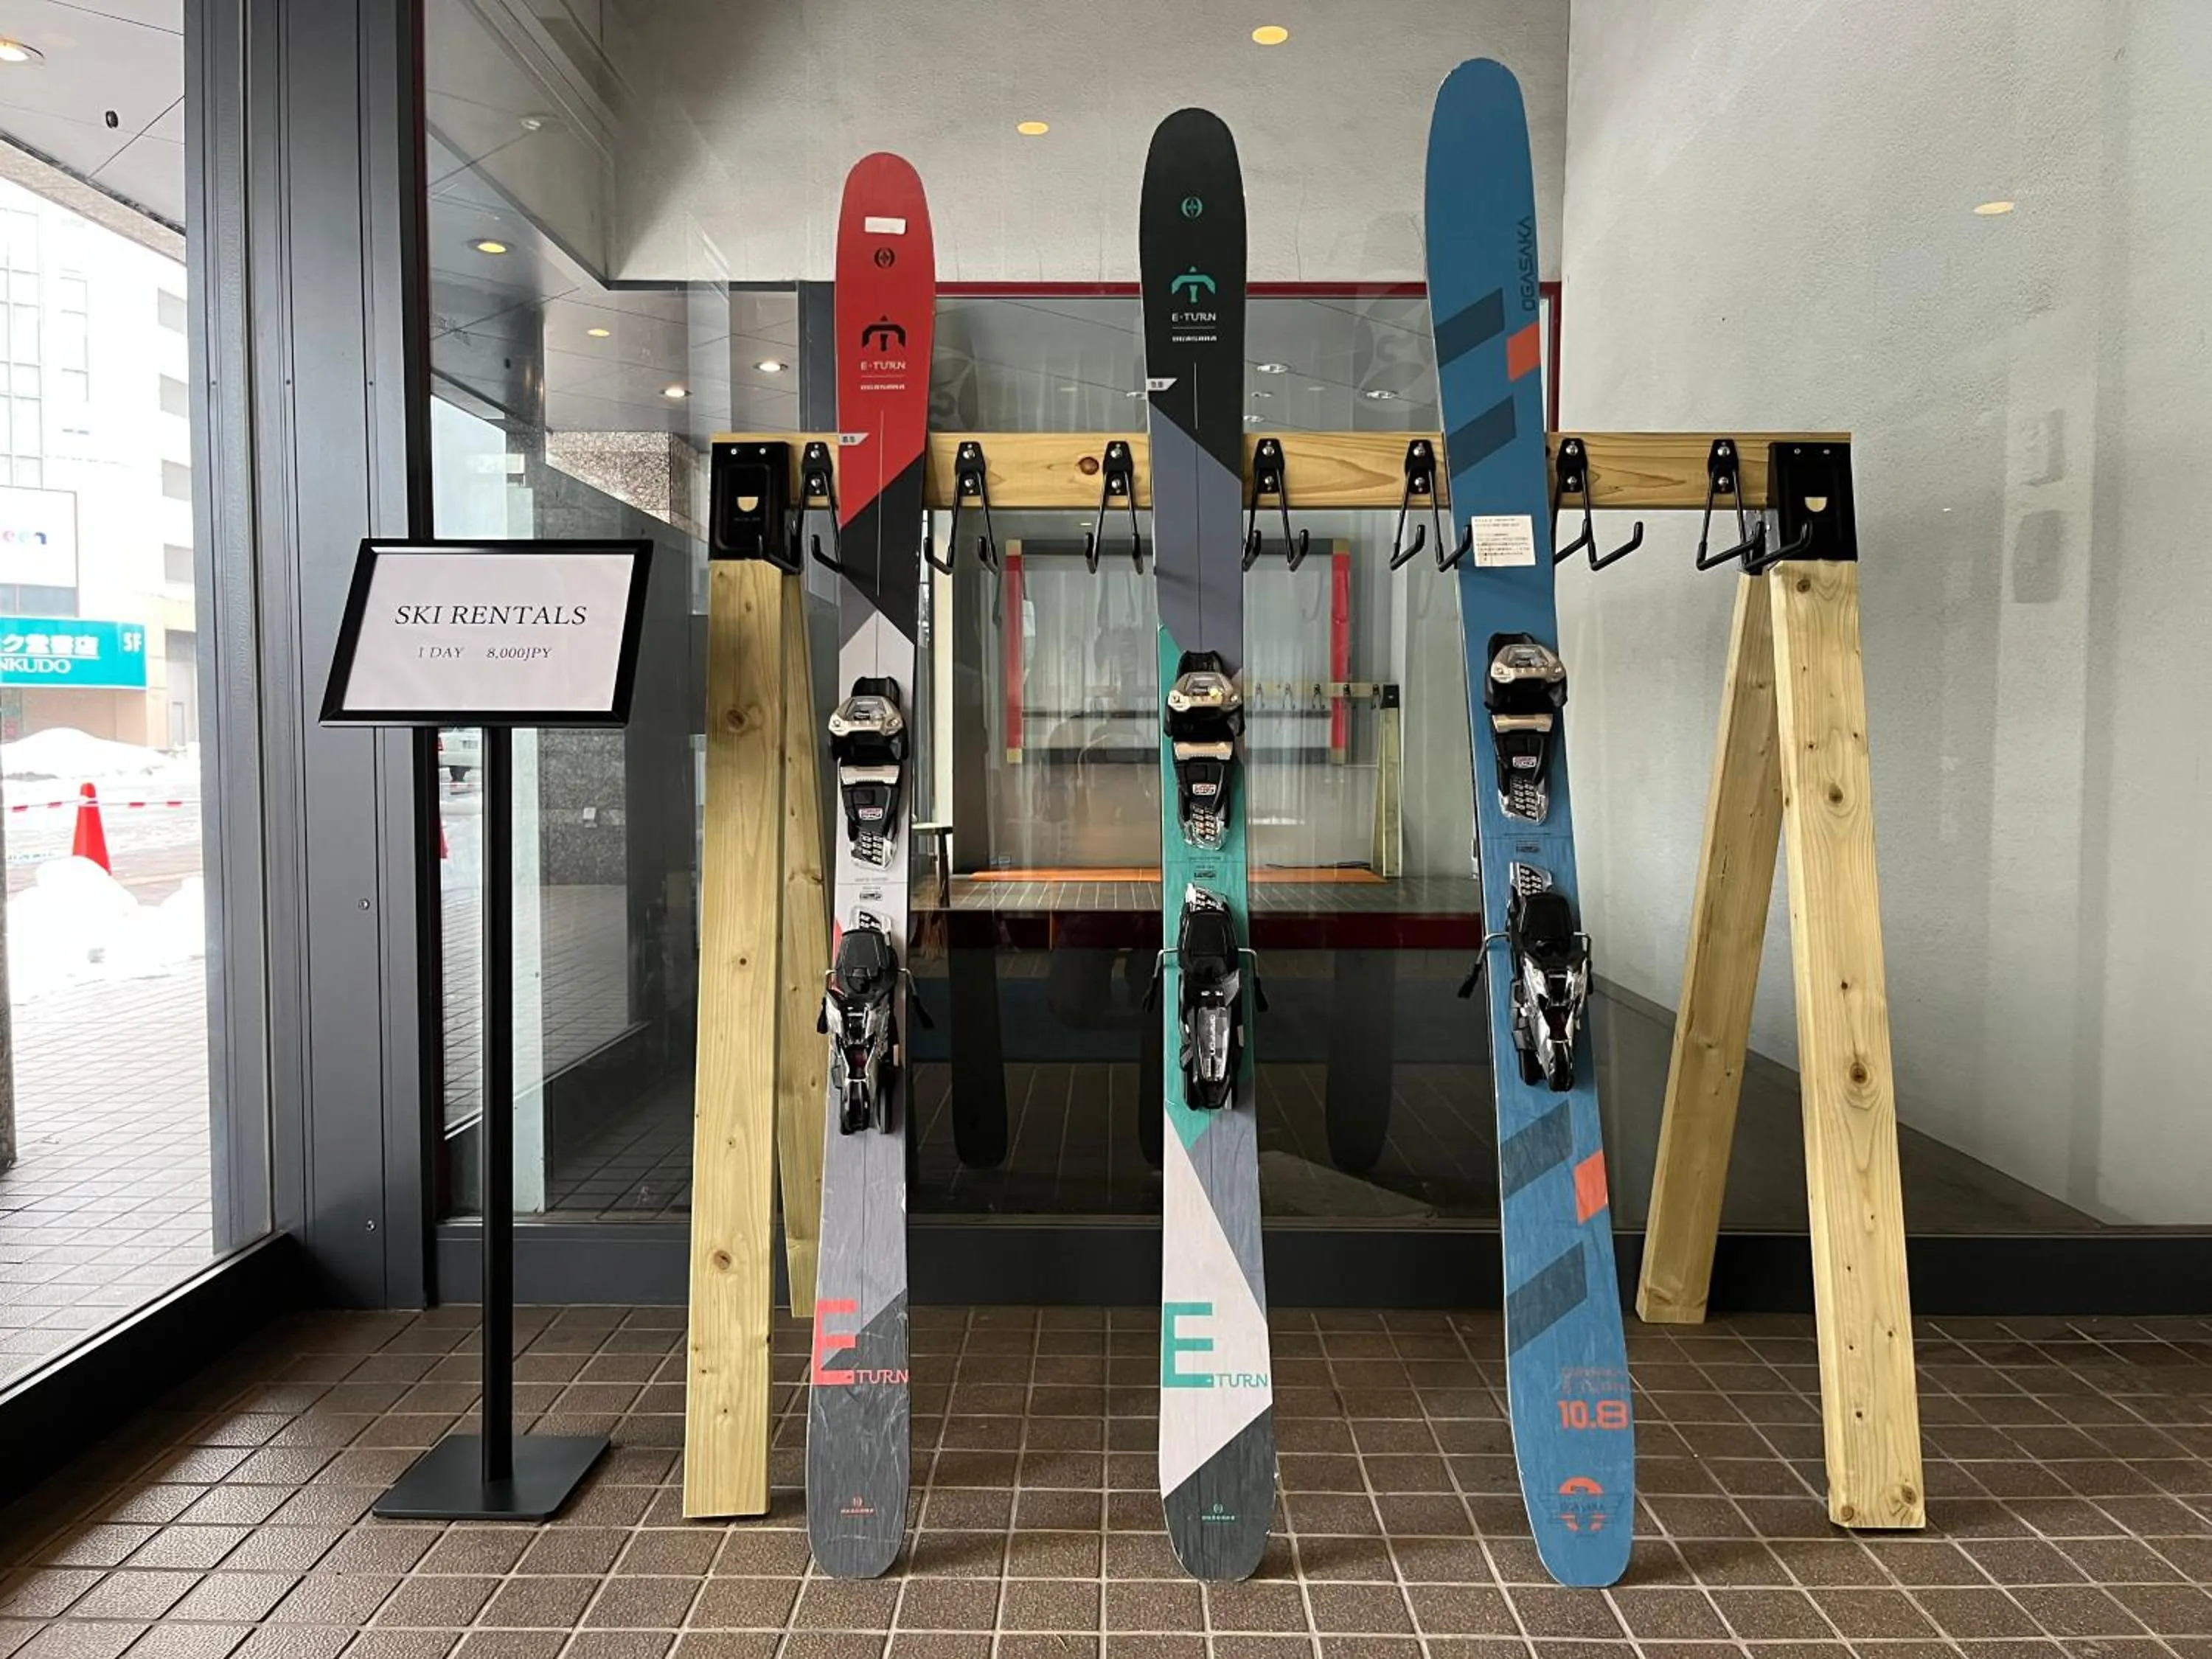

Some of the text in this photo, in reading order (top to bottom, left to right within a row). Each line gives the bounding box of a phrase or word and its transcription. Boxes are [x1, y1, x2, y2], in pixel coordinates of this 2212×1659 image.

[1517, 215, 1535, 312] OGASAKA
[394, 605, 588, 626] SKI RENTALS
[429, 646, 465, 658] DAY
[1557, 1399, 1630, 1430] 10.8
